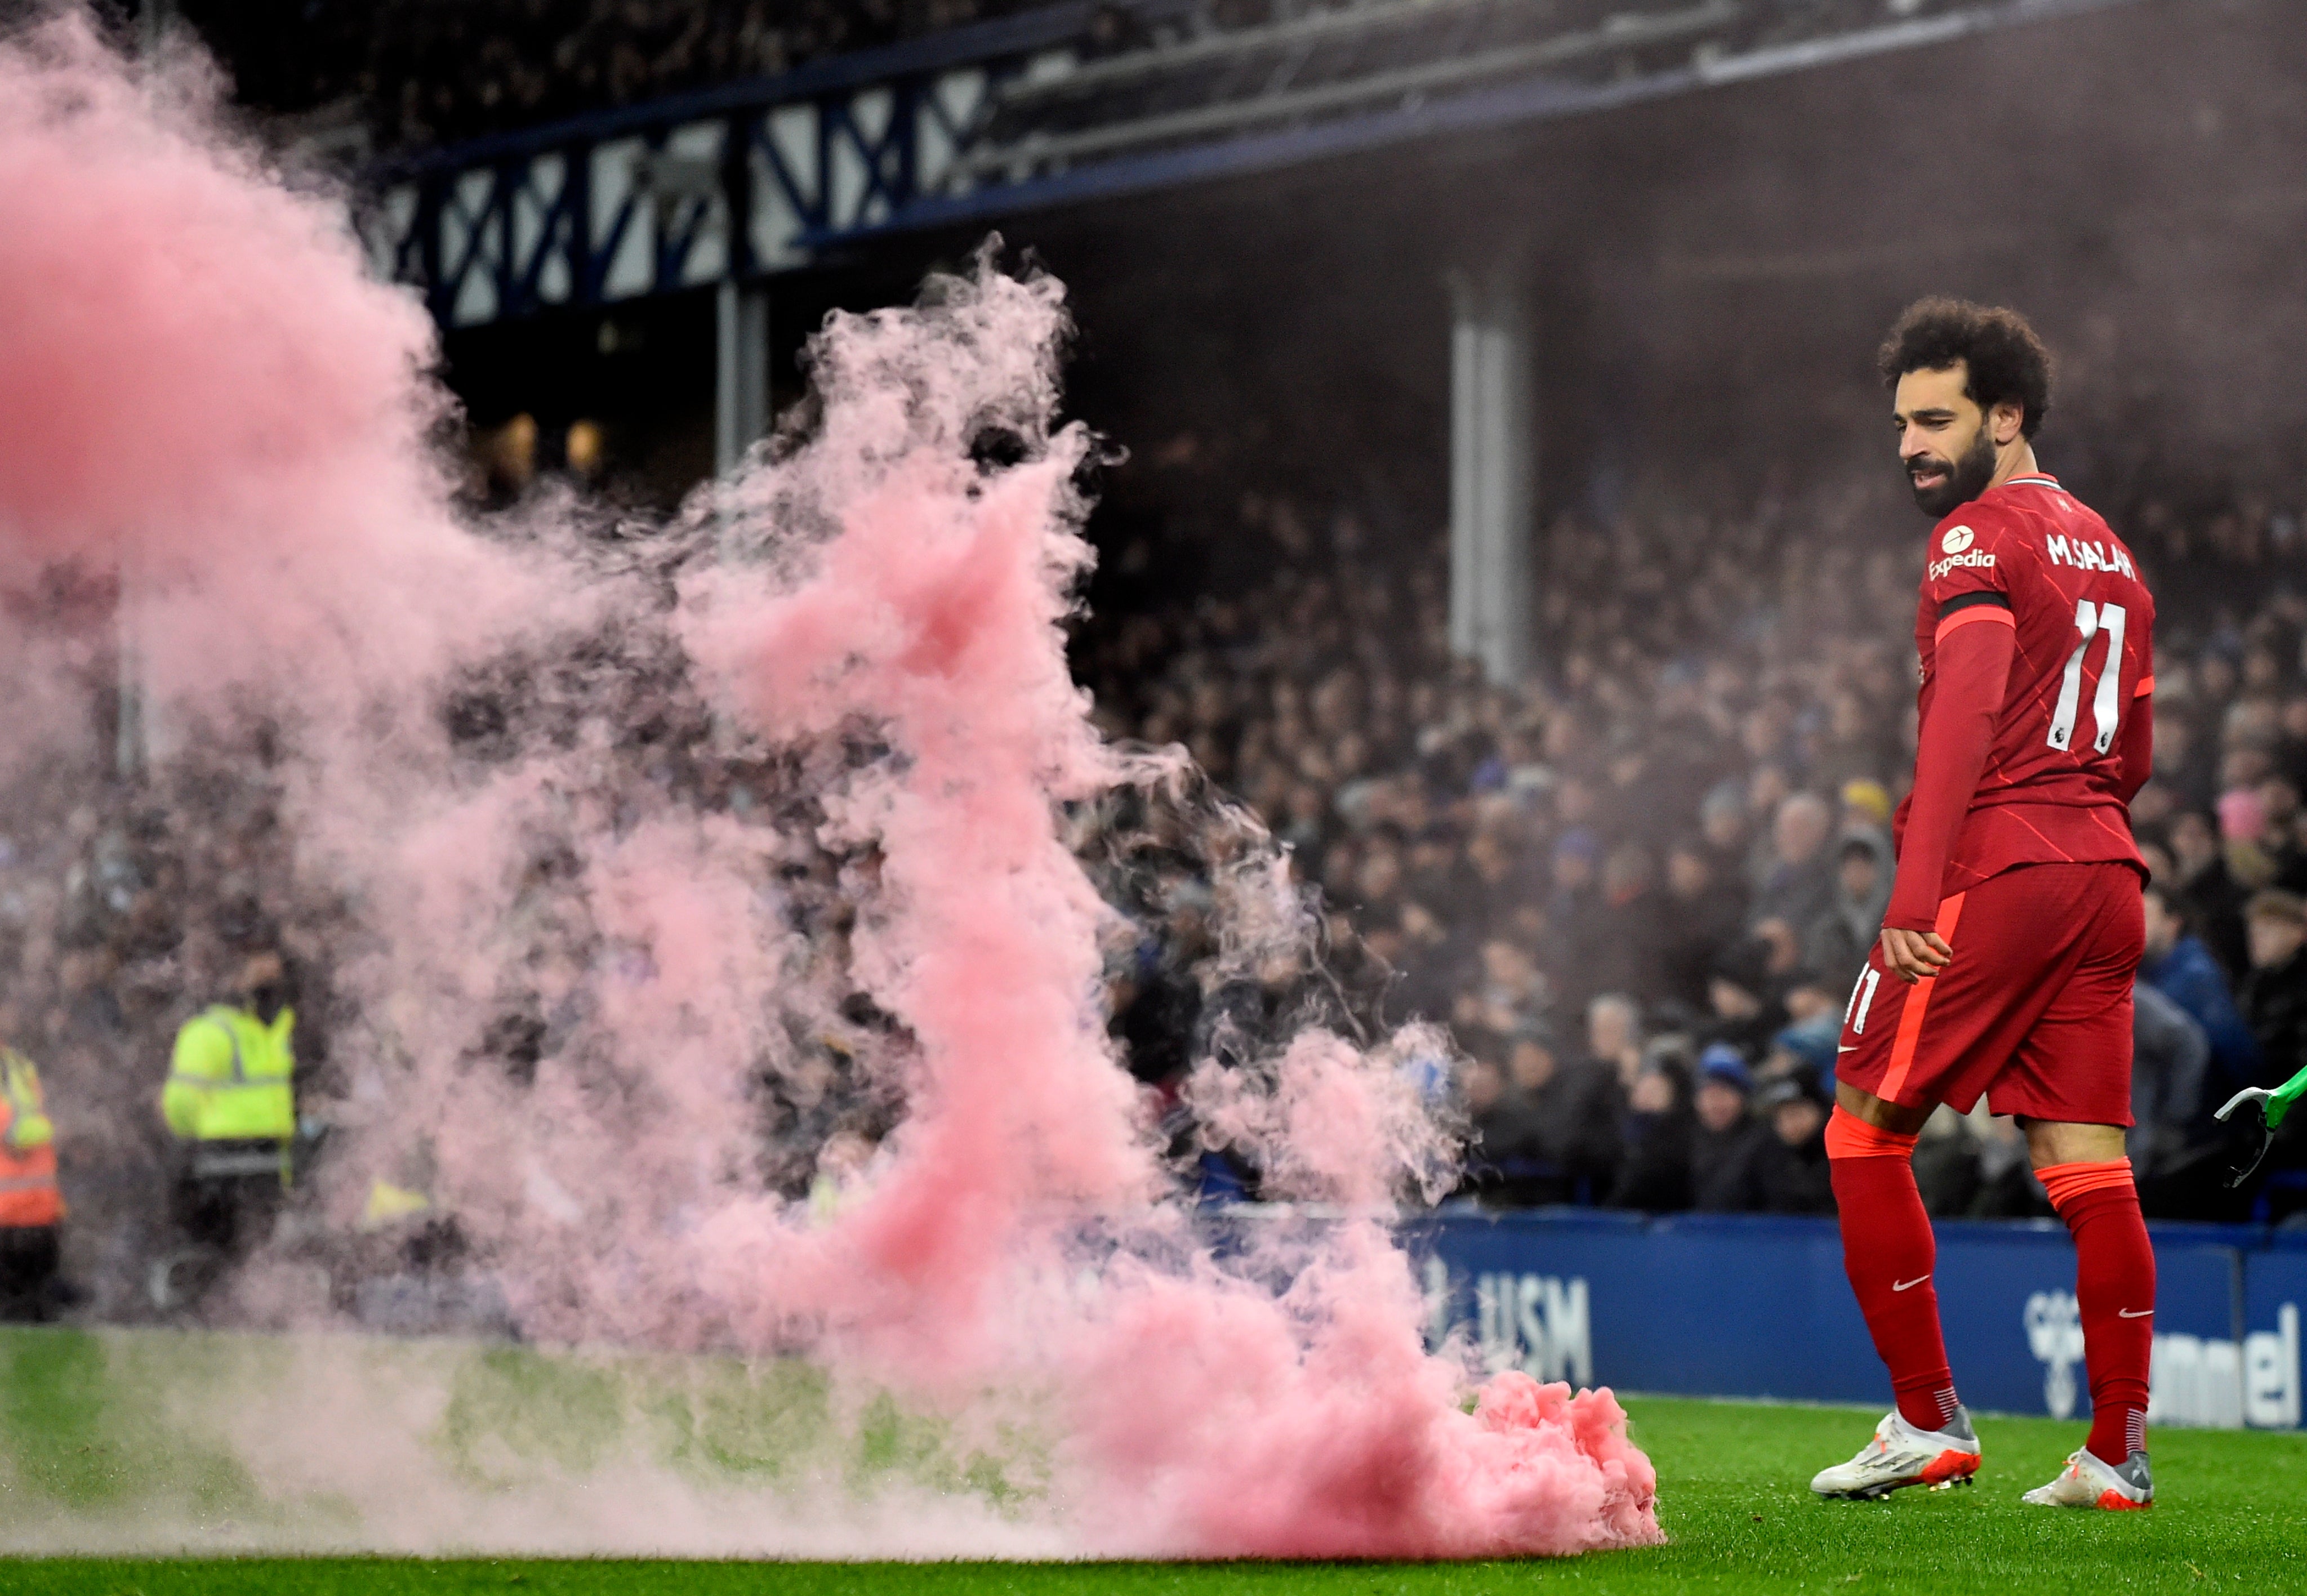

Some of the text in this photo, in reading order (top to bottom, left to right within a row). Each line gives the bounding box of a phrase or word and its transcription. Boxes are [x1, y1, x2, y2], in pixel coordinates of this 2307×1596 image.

[1929, 549, 1996, 581] Expedia
[2047, 533, 2136, 582] M.SALAH
[2046, 598, 2126, 755] 11
[1477, 1273, 1593, 1387] USM
